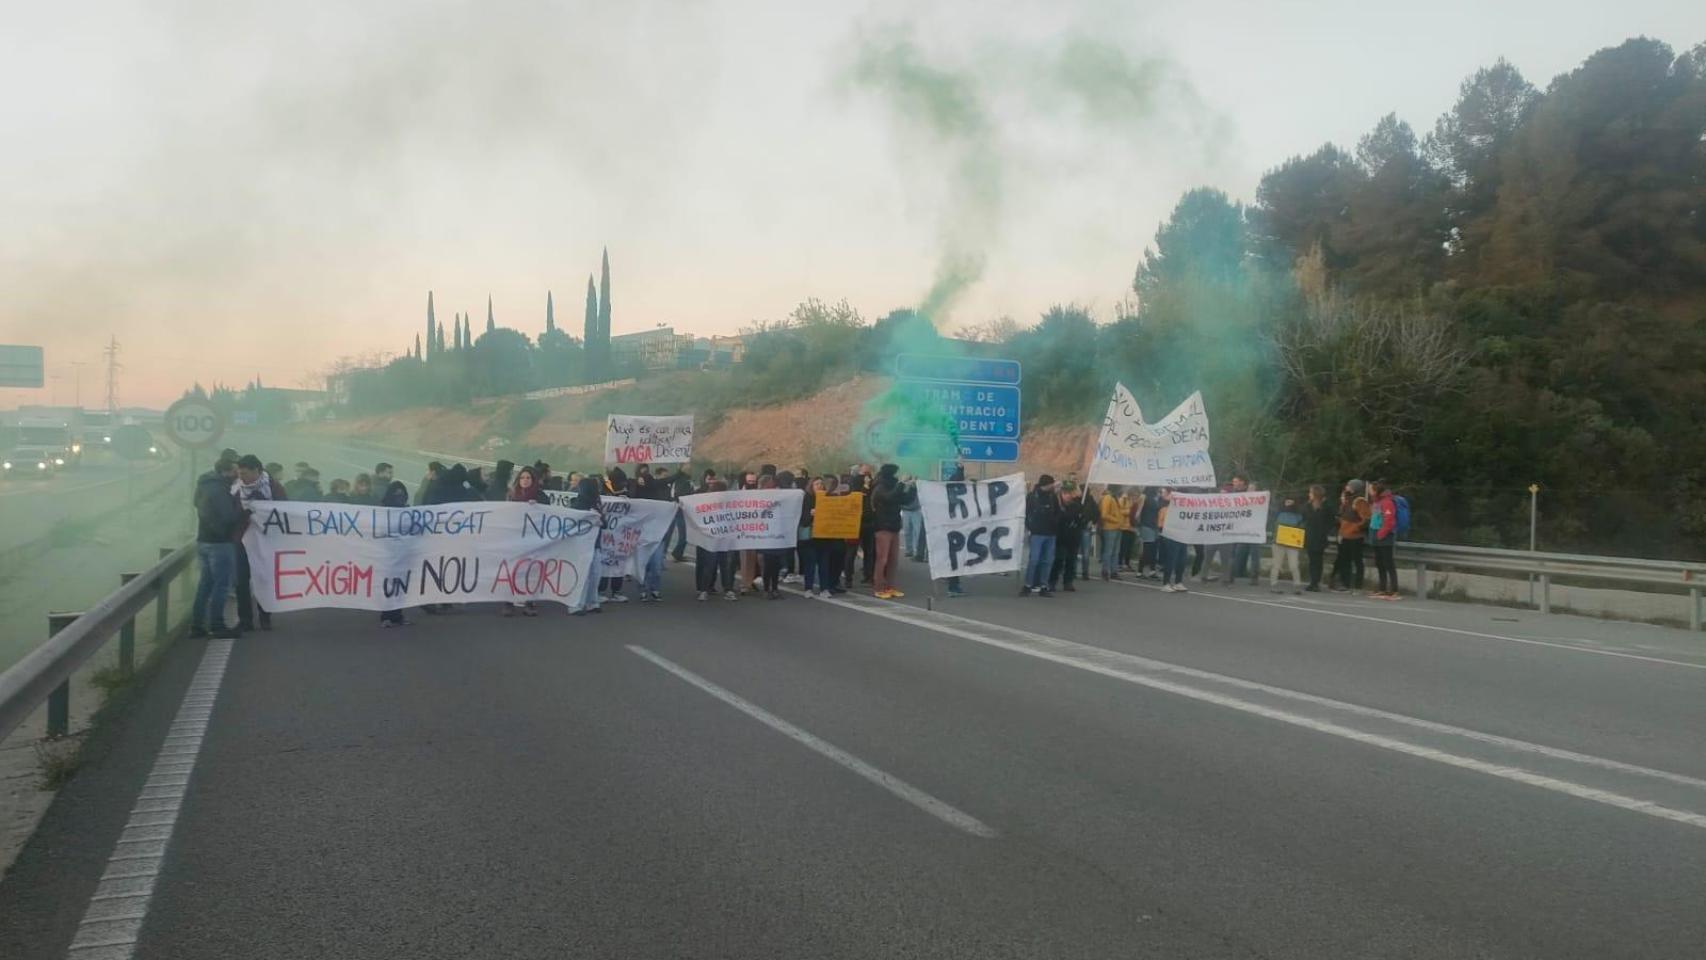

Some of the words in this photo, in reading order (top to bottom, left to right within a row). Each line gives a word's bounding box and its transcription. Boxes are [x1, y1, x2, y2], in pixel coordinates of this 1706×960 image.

[924, 389, 961, 401] TRAM
[977, 391, 994, 401] DE
[176, 415, 215, 432] 100
[614, 443, 653, 464] VAGA
[1147, 459, 1168, 471] EL
[946, 481, 1009, 519] RIP
[703, 515, 715, 525] LA
[716, 510, 759, 522] INCLUSIÓ
[1179, 511, 1201, 520] QUE
[1201, 509, 1253, 520] SEGUIDORS
[263, 507, 302, 536] AL
[306, 508, 364, 538] BAIX
[372, 508, 494, 539] LLOBREGAT
[521, 512, 595, 540] NORD
[710, 525, 729, 536] UNA
[1197, 523, 1204, 532] A
[947, 526, 1013, 571] PSC
[383, 569, 412, 599] UN
[420, 556, 480, 596] NOU
[491, 558, 579, 597] ACORD
